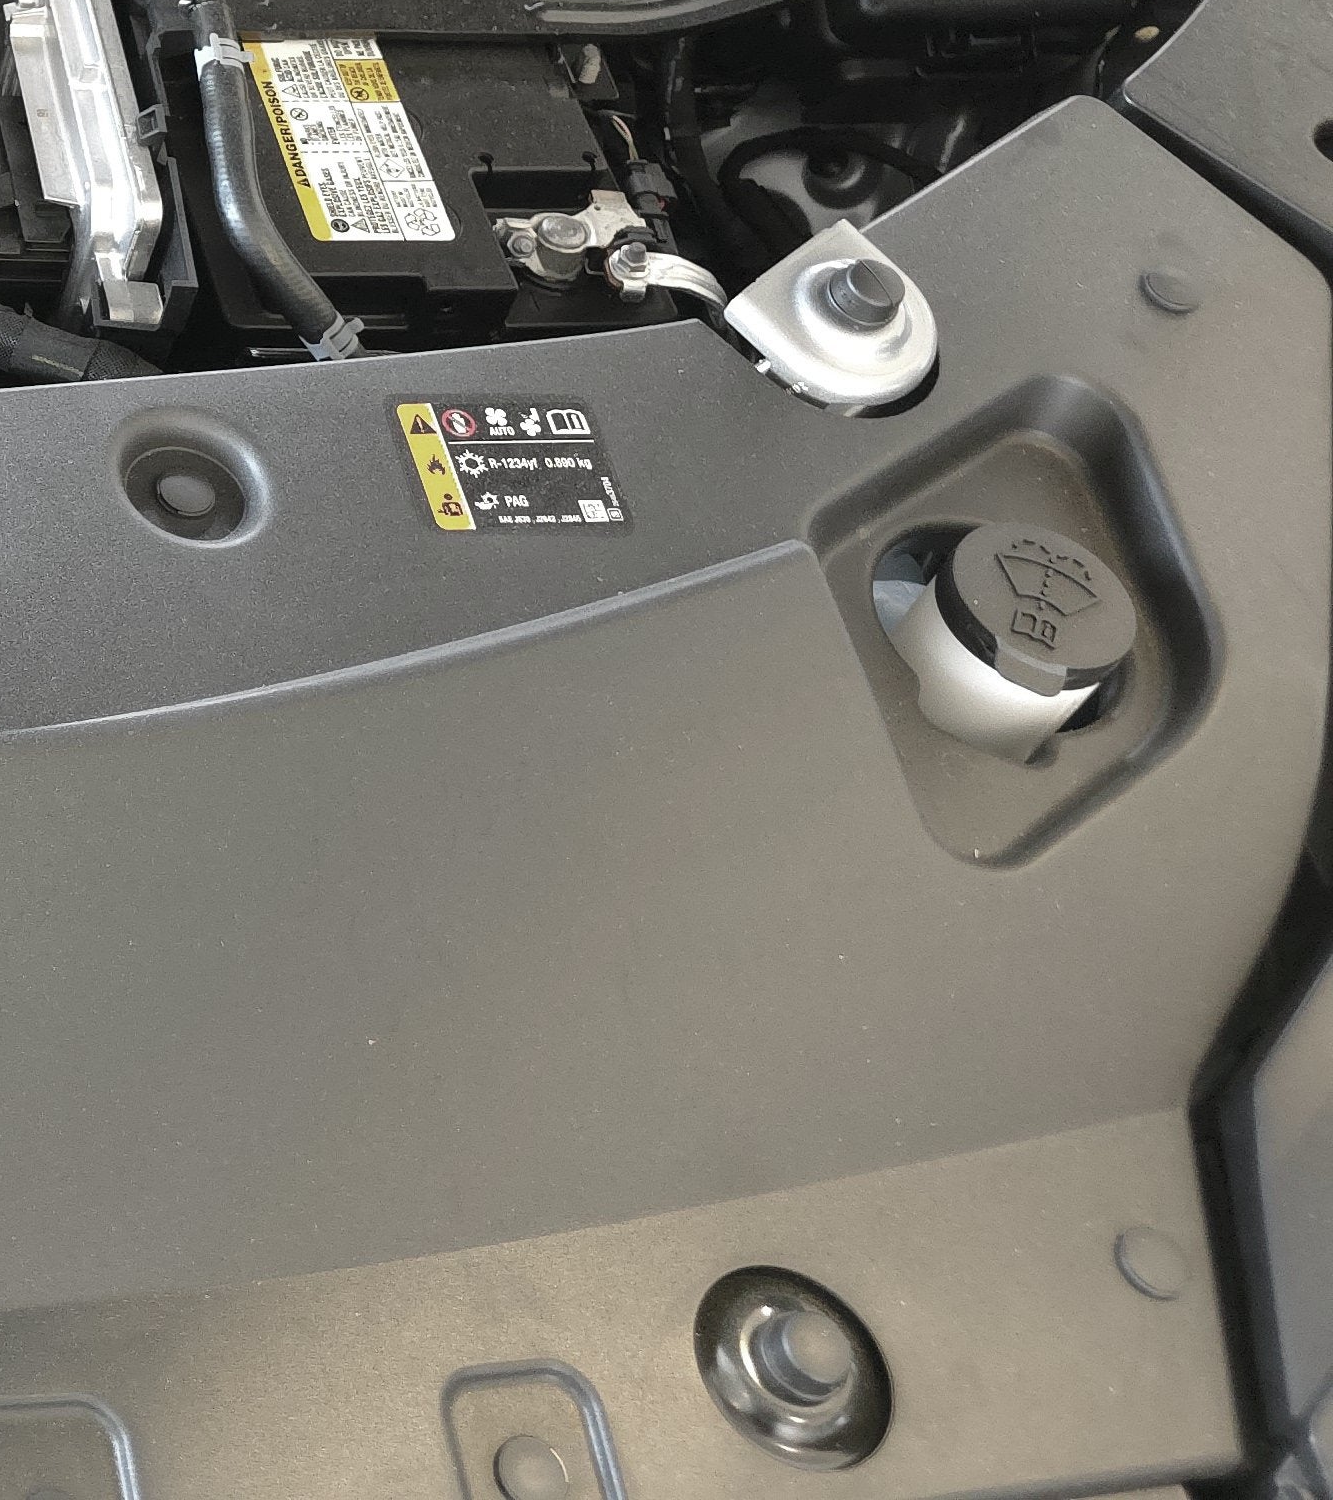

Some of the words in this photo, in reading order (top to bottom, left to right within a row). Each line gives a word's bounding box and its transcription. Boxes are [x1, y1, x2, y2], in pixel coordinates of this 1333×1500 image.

[262, 82, 305, 176] DANGER/POISON
[489, 426, 515, 436] AUTO
[488, 457, 538, 470] R-1234yf
[576, 457, 593, 470] kg
[504, 494, 529, 507] PAG
